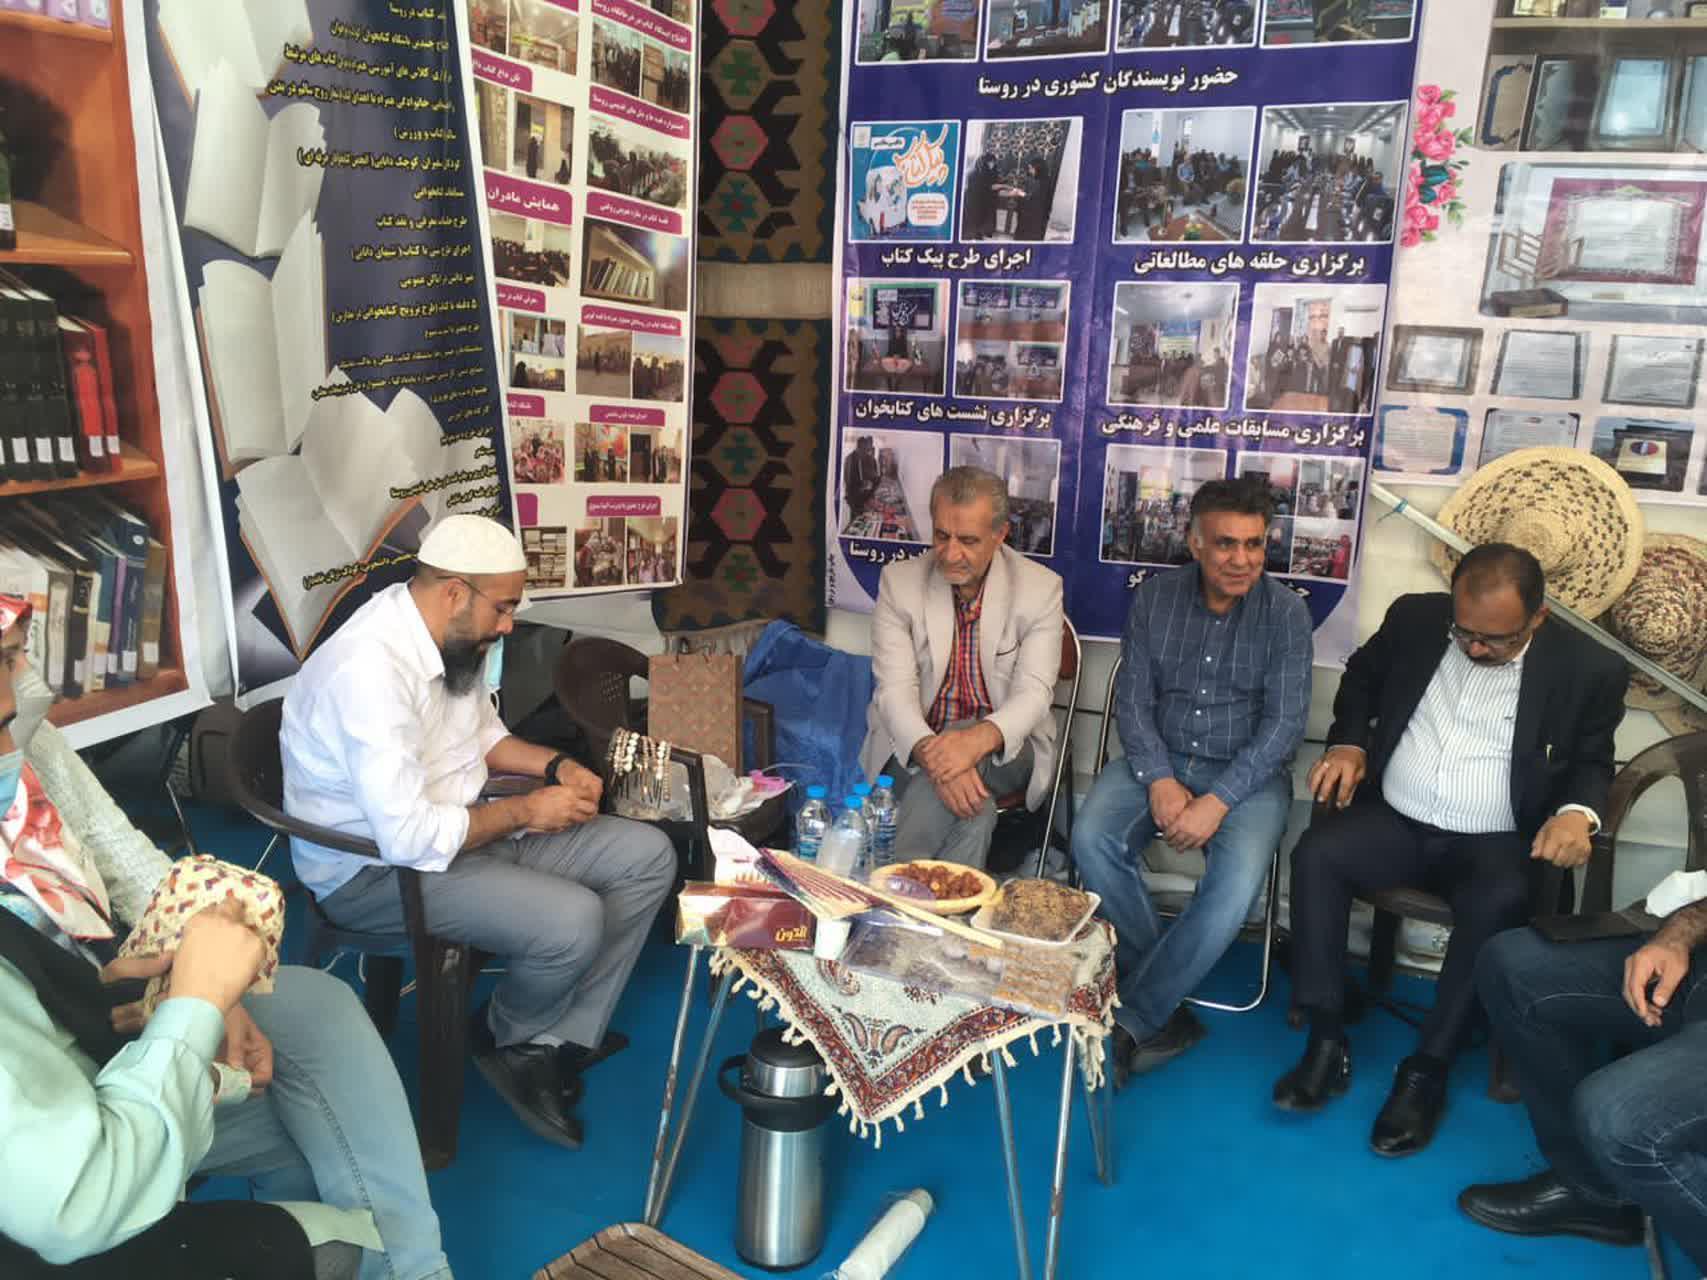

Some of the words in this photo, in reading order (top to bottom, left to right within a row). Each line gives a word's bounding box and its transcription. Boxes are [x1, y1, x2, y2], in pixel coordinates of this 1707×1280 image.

[978, 77, 1018, 99] روستا
[1023, 78, 1040, 98] در
[1044, 71, 1099, 97] کشوری
[1103, 67, 1185, 94] نویسندگان
[1189, 67, 1239, 91] حضور
[487, 187, 521, 204] مادران
[523, 196, 560, 212] همایش
[881, 247, 913, 268] کتاب
[917, 247, 944, 270] پیک
[947, 248, 980, 268] طرح
[984, 248, 1031, 269] اجرای
[1134, 250, 1207, 274] مطالعاتی
[1211, 251, 1245, 274] های
[1250, 251, 1288, 269] حلقه
[1292, 253, 1364, 276] برگزاری
[855, 399, 914, 420] کتابخوان
[917, 402, 944, 422] های
[947, 404, 988, 420] نشست
[991, 407, 1051, 429] برگزاری
[1102, 413, 1160, 435] فرهنگی
[1166, 422, 1174, 437] و
[1178, 417, 1220, 438] علمی
[1225, 418, 1290, 442] مسابقات
[1294, 423, 1365, 447] برگزاری
[850, 541, 885, 563] روستا
[1127, 569, 1147, 588] گو
